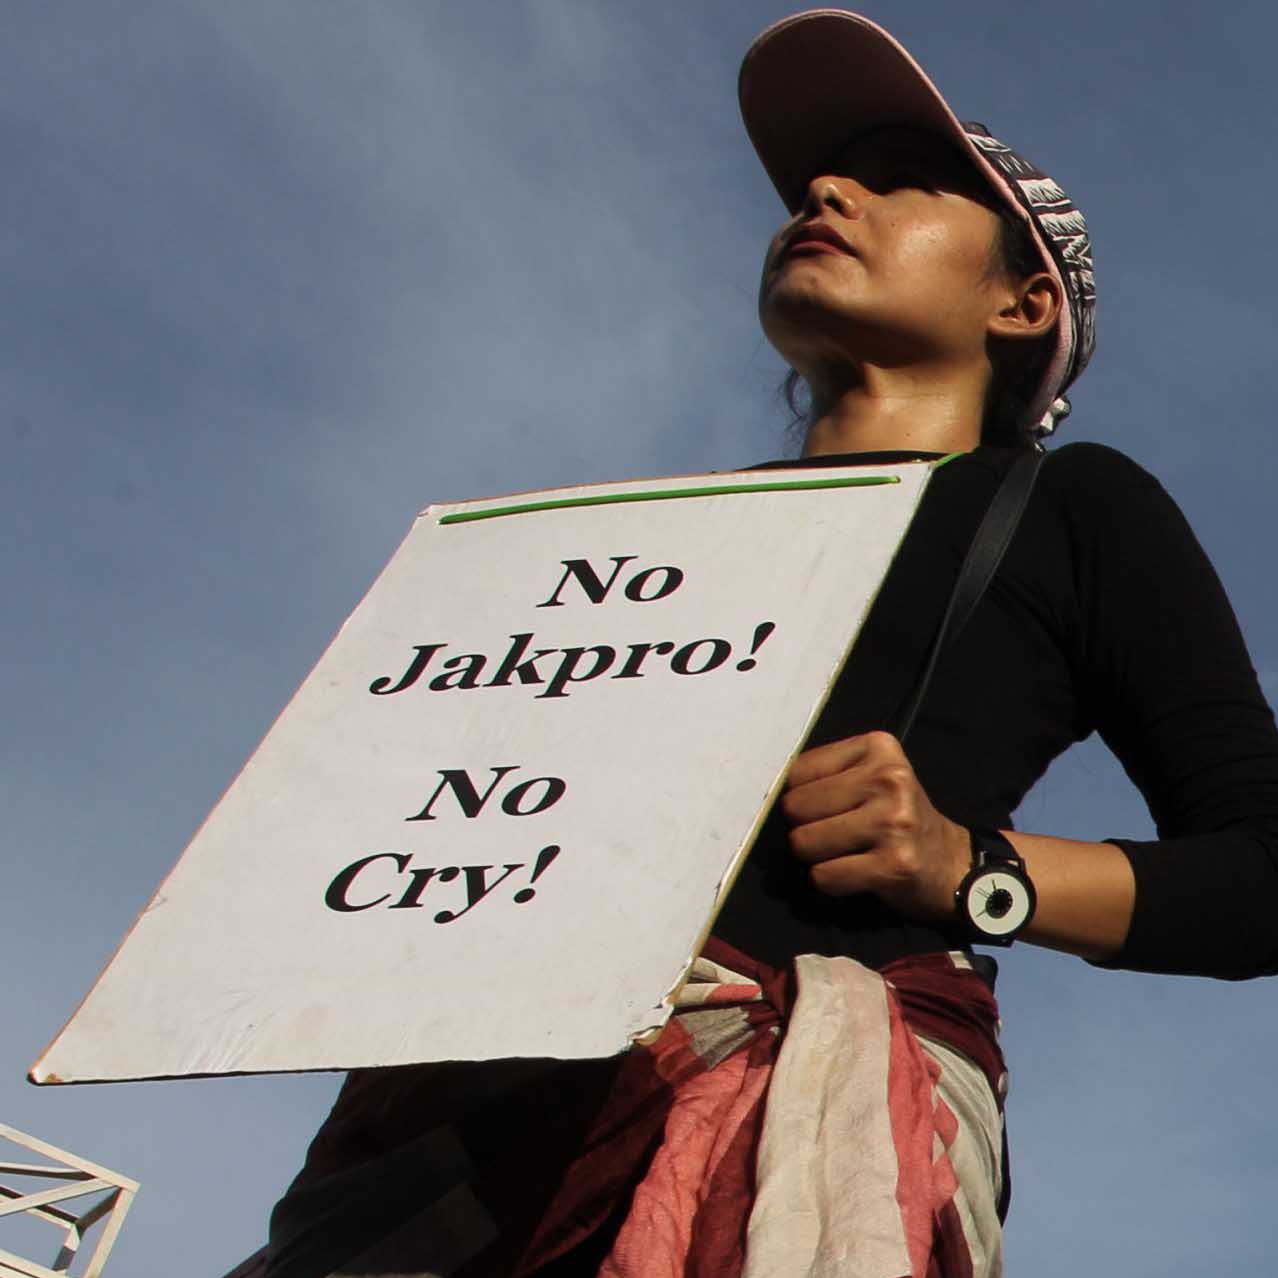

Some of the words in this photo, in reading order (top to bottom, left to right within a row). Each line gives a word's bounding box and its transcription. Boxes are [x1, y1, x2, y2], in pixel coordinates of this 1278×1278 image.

[536, 555, 684, 608] No
[369, 621, 776, 699] Jakpro!
[405, 765, 566, 822] No
[324, 845, 561, 924] Cry!
